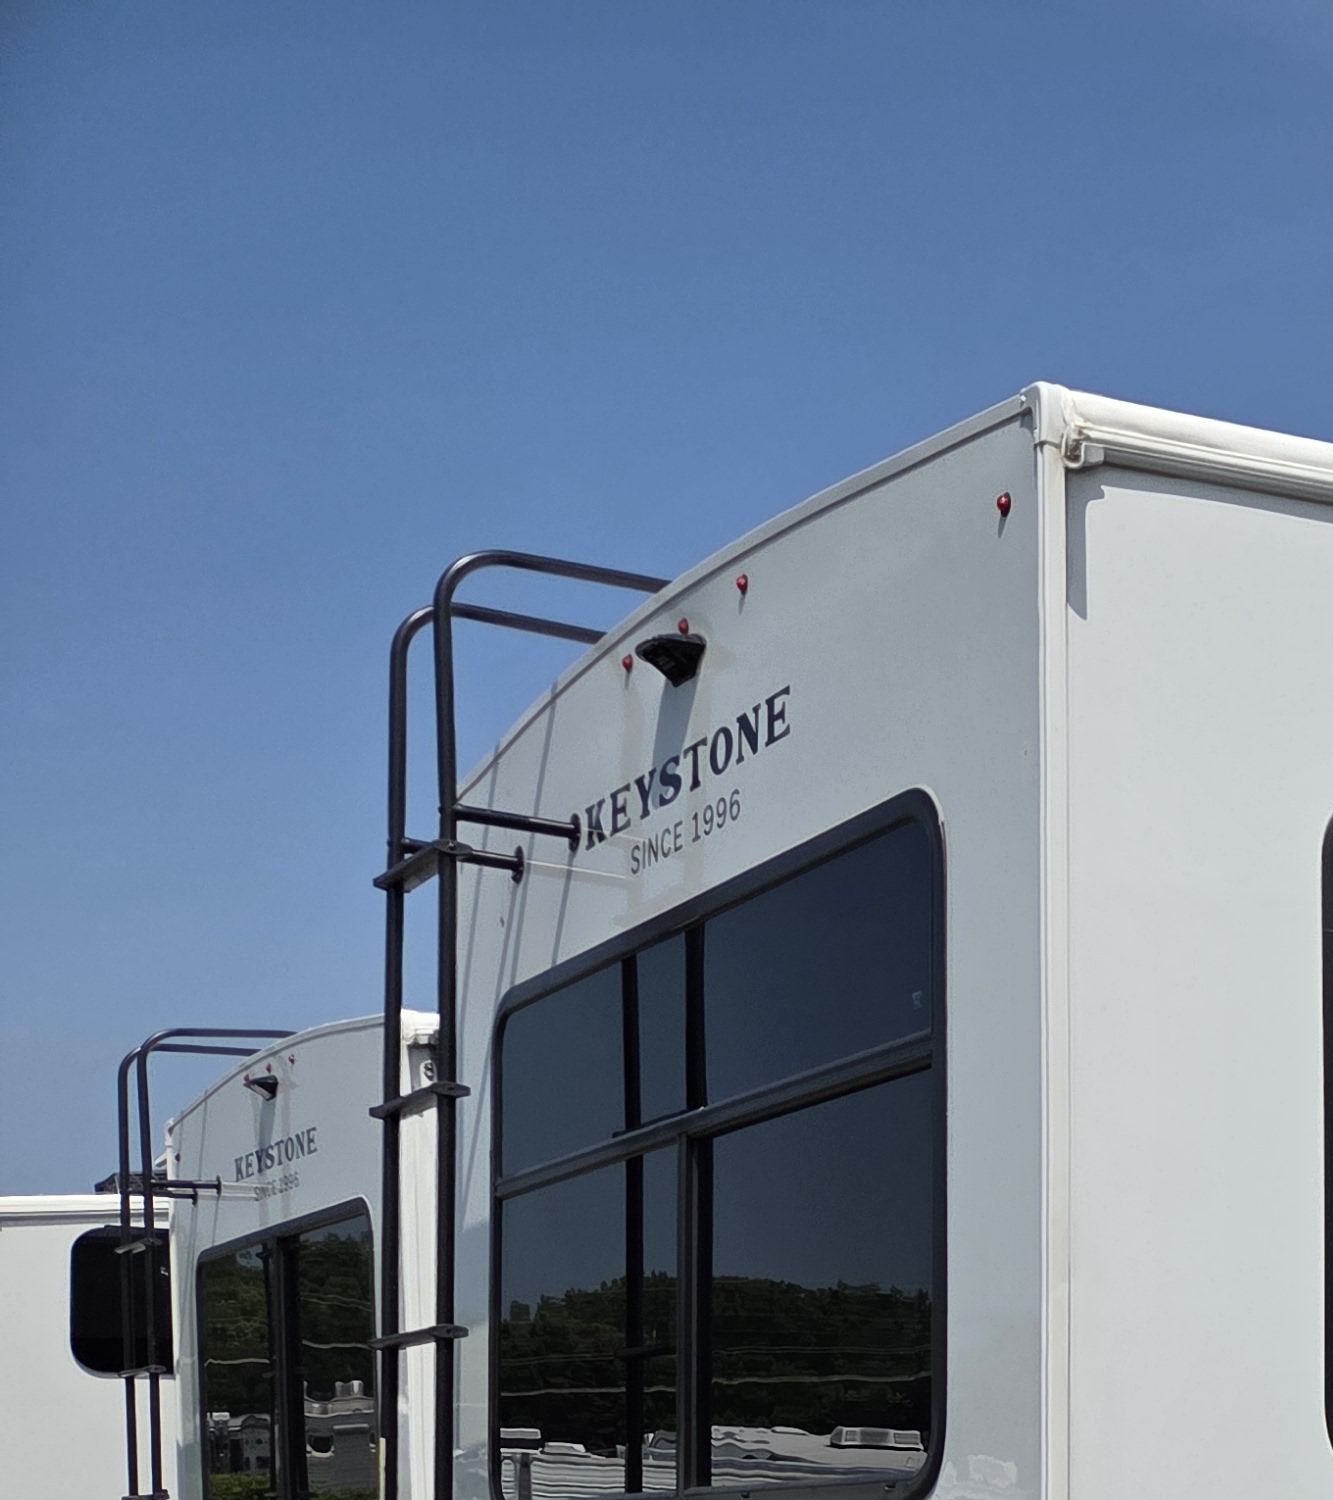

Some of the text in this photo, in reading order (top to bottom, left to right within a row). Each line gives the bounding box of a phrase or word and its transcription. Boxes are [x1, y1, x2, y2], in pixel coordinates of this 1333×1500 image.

[585, 684, 791, 851] KEYSTONE
[630, 788, 741, 875] SINCE 1996
[234, 1126, 318, 1182] KEYSTONE
